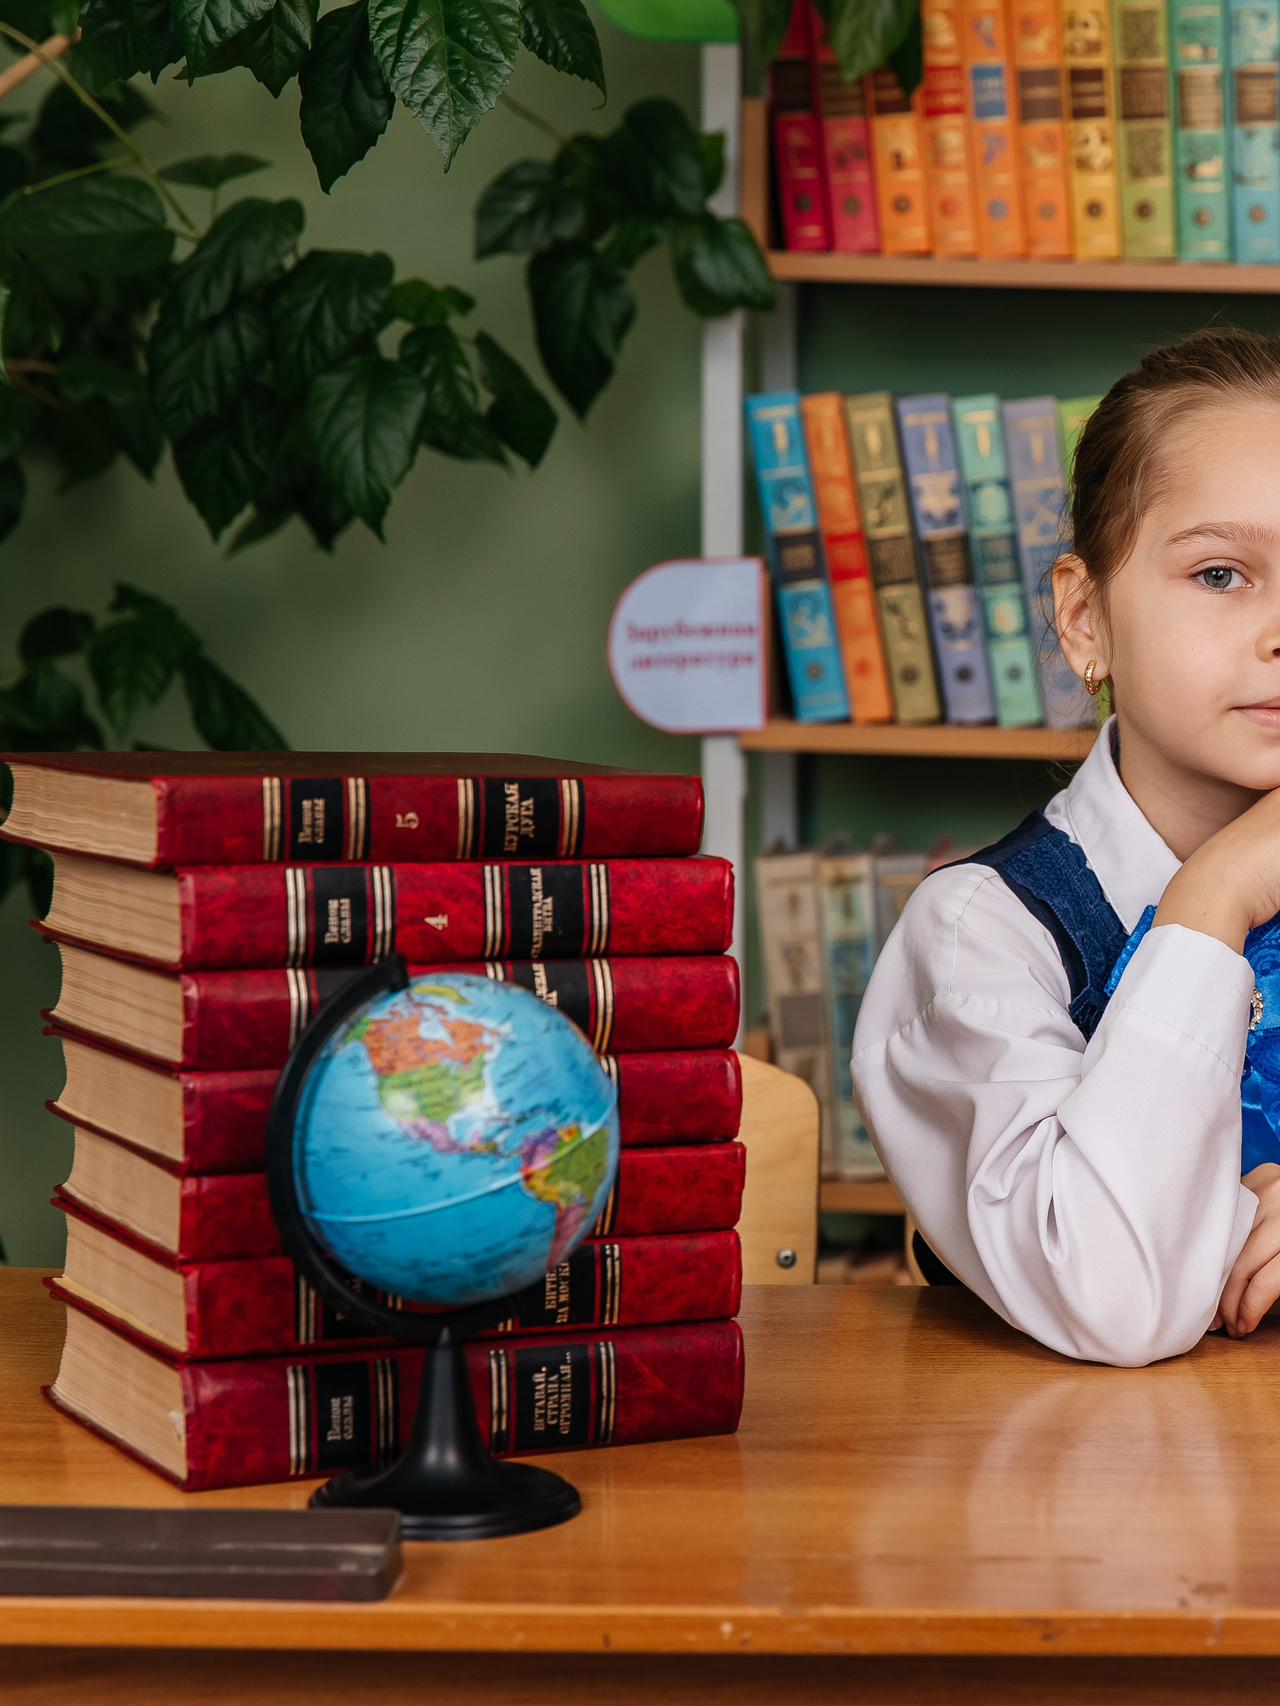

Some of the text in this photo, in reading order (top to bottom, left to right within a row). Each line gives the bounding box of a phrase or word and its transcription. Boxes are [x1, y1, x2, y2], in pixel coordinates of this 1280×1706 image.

[313, 797, 325, 844] славы
[395, 812, 420, 829] 5
[503, 782, 519, 852] КУРСКАЯ
[519, 797, 535, 838] ДУГА
[339, 898, 352, 943] славы
[424, 914, 449, 930] 4
[542, 896, 554, 932] БИТВА
[544, 1268, 558, 1310] БИТВ
[556, 1261, 571, 1304] МОСК
[341, 1395, 354, 1441] славы
[547, 1374, 560, 1425] СТРАНА
